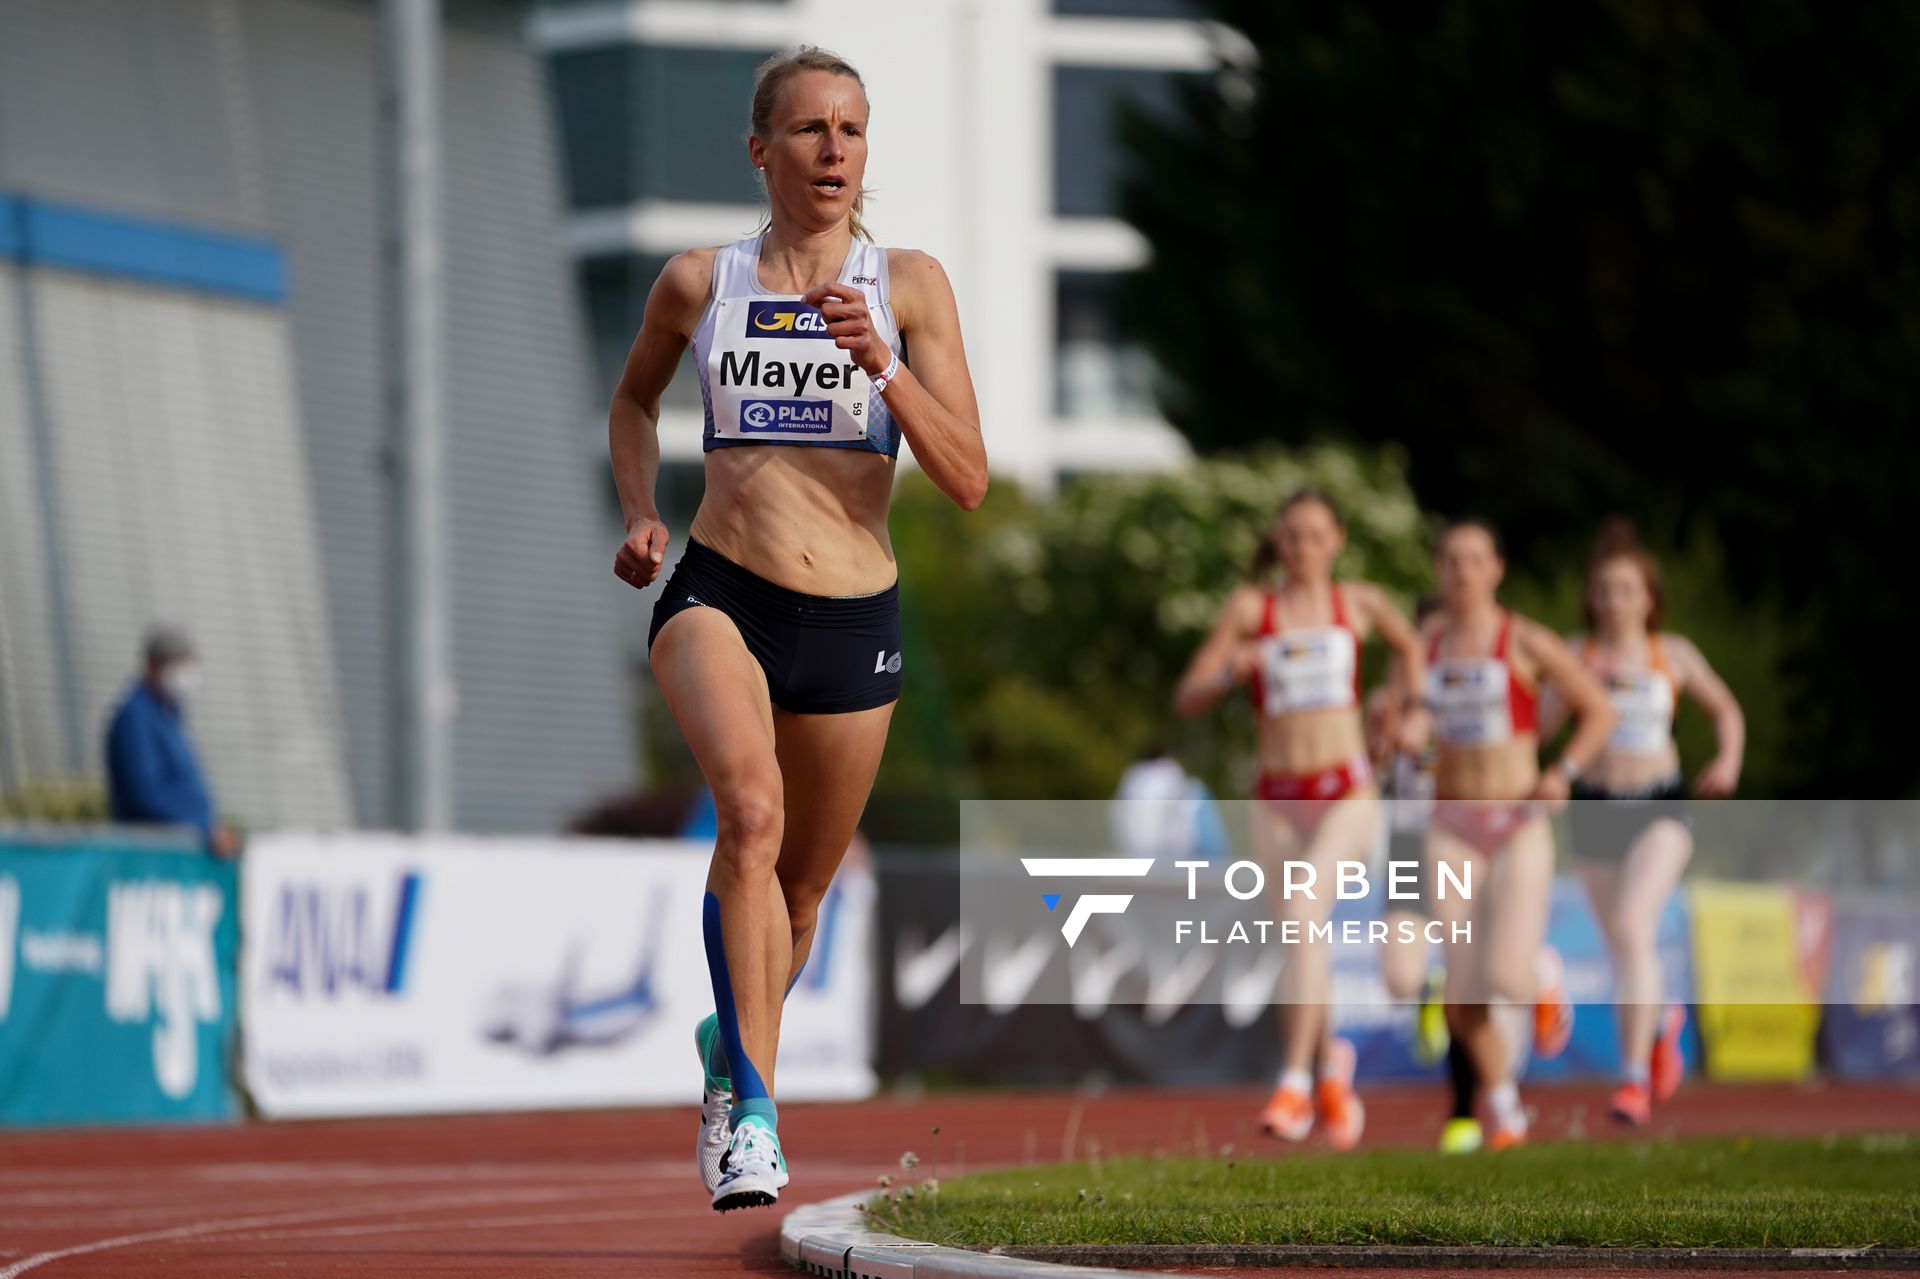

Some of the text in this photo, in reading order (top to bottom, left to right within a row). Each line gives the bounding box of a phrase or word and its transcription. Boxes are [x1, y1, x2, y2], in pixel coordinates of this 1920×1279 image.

[720, 351, 859, 397] Mayer
[778, 406, 828, 422] PLAN
[853, 402, 863, 416] 59
